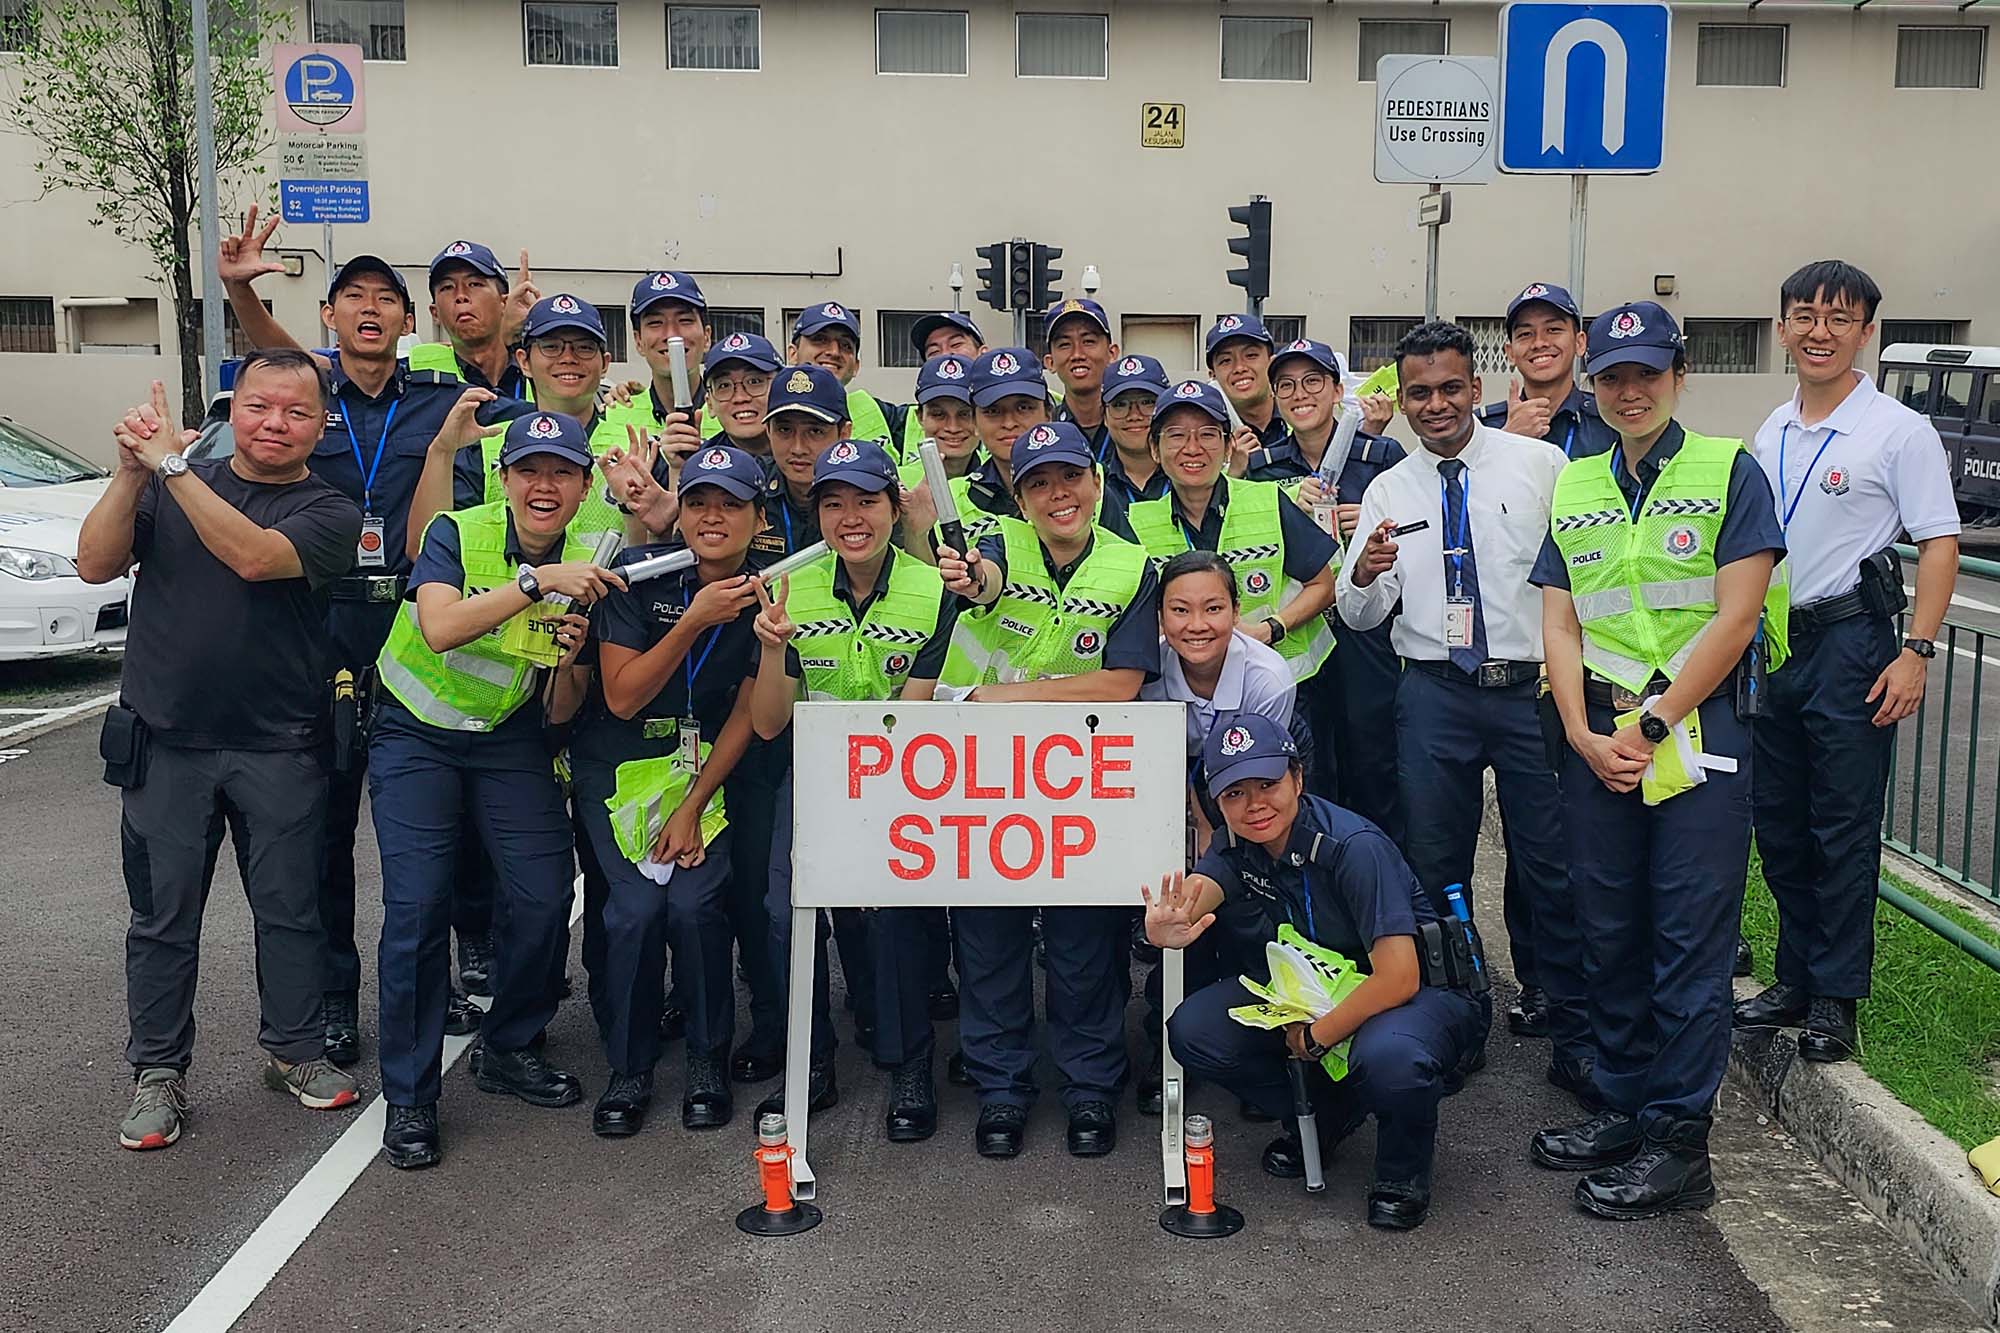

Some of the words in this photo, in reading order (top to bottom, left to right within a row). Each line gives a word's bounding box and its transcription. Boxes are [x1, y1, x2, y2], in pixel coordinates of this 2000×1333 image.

[1387, 100, 1489, 118] PEDESTRIANS
[1147, 106, 1179, 129] 24
[1390, 126, 1416, 141] Use
[1422, 127, 1485, 146] Crossing
[288, 141, 324, 149] Motorcar
[326, 142, 358, 150] Parking
[283, 155, 295, 163] 50
[288, 184, 328, 194] Overnight
[330, 185, 361, 195] Parking
[289, 200, 301, 209] $2
[1572, 550, 1602, 565] POLICE
[1001, 618, 1034, 636] POLICE
[803, 659, 835, 667] POLICE
[847, 733, 1135, 800] POLICE
[887, 813, 1096, 880] STOP
